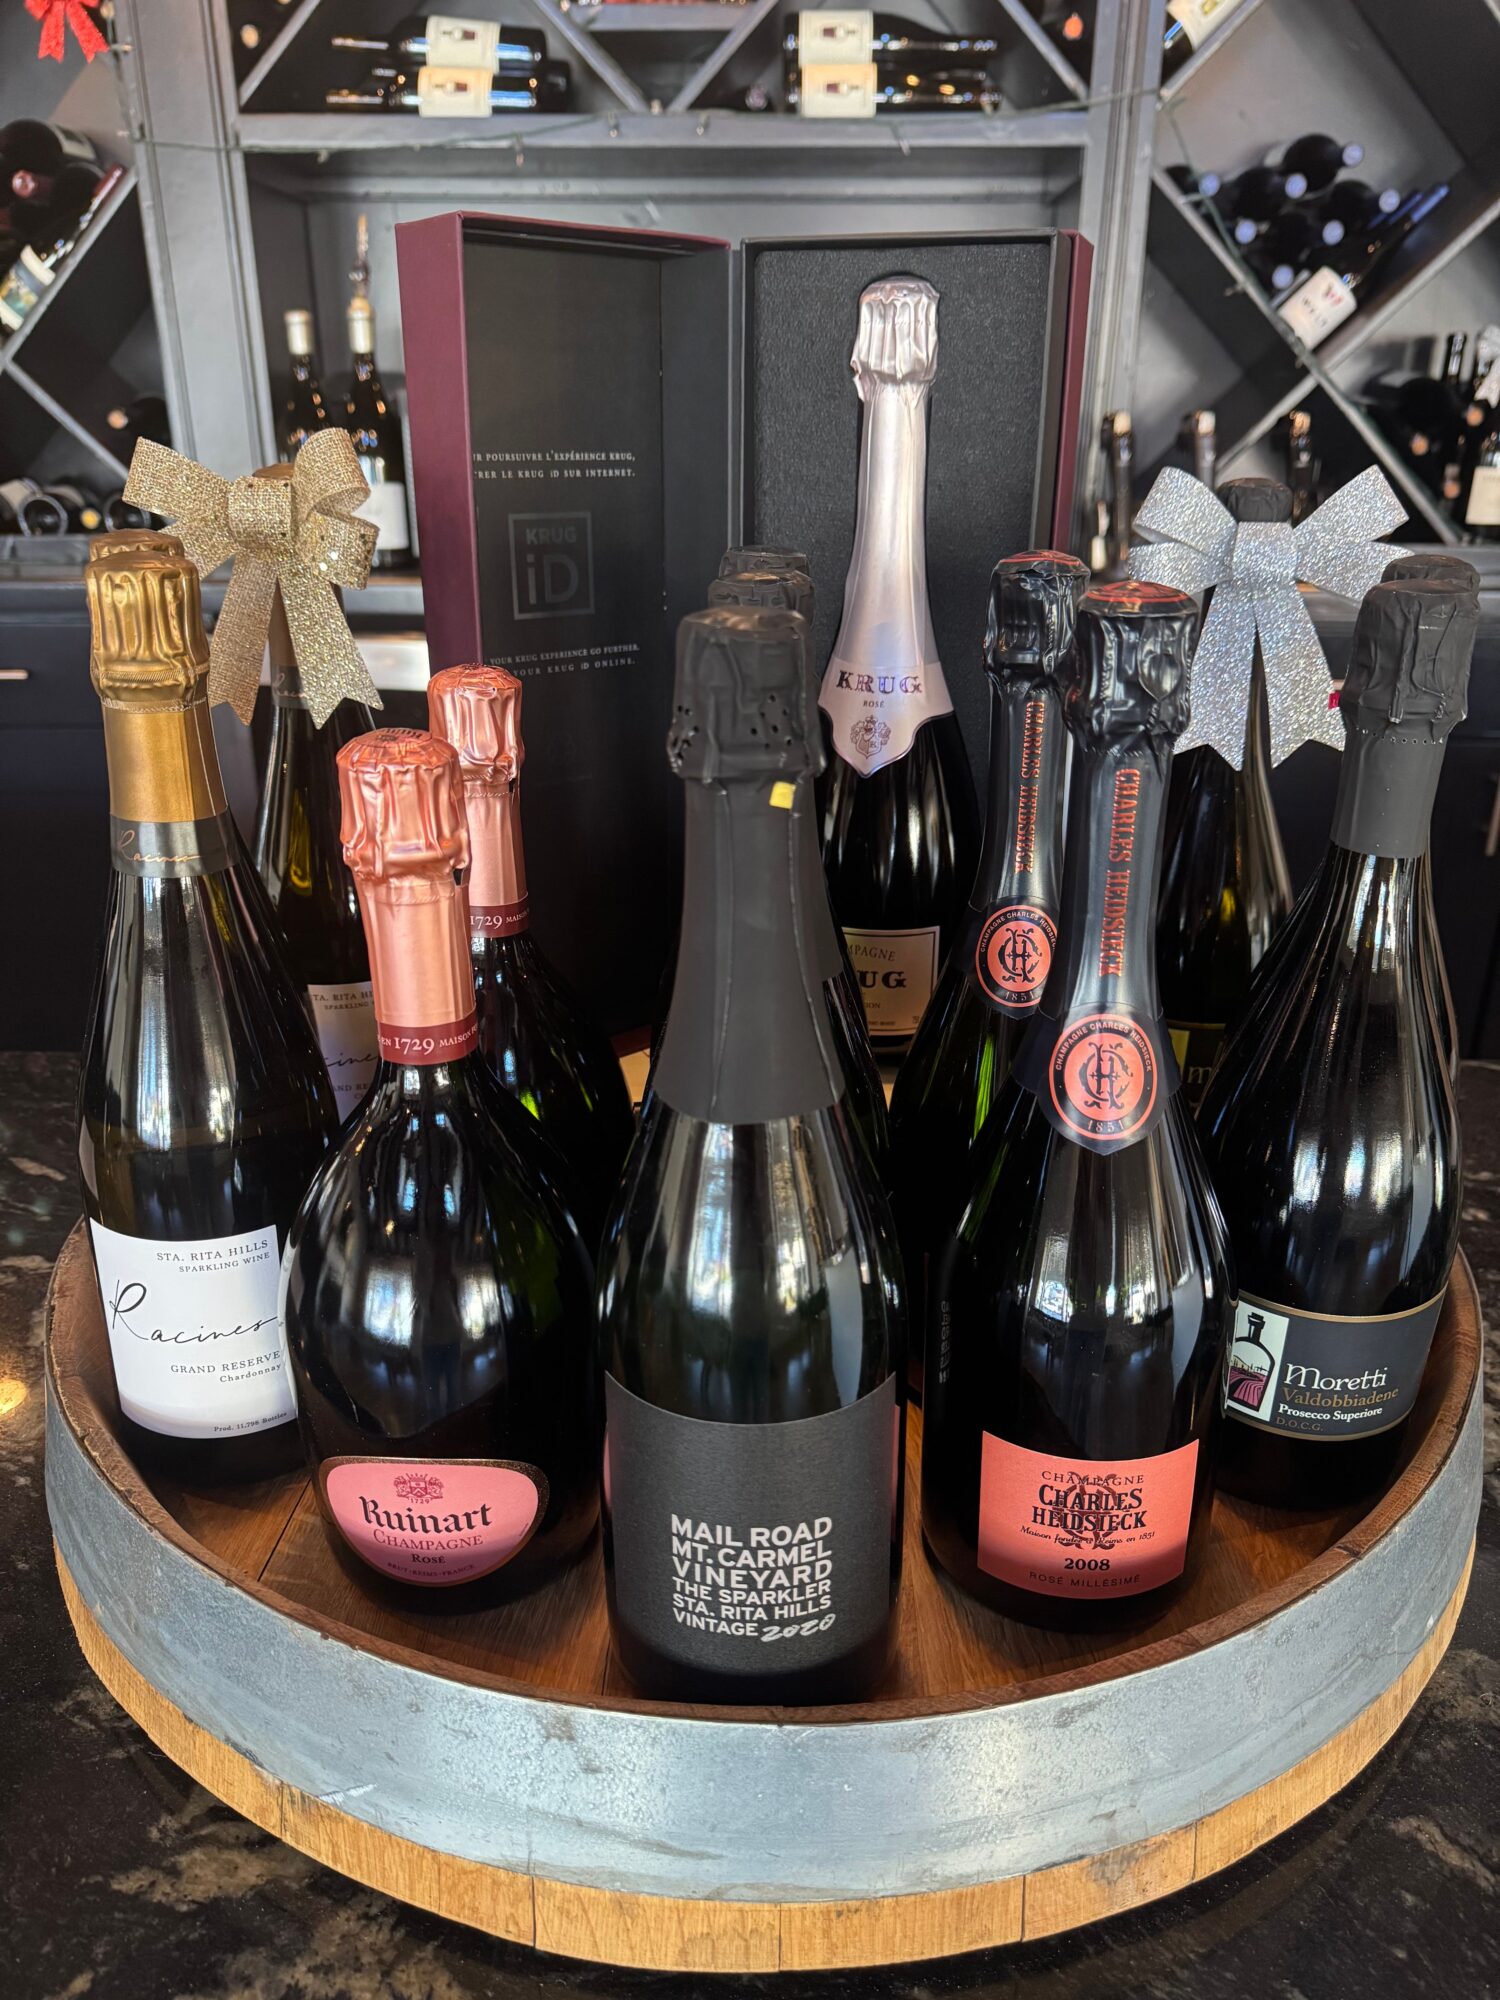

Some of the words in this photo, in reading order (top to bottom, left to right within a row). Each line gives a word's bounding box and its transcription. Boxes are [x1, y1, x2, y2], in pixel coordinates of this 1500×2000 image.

[486, 452, 543, 462] POURSUIVRE
[502, 470, 513, 478] LE
[518, 470, 544, 478] KRUG
[564, 469, 582, 478] SUR
[526, 527, 577, 545] KRUG
[526, 554, 580, 605] iD
[490, 656, 513, 666] YOUR
[515, 654, 538, 664] KRUG
[540, 650, 589, 662] EXPERIENCE
[590, 648, 602, 656] GO
[548, 663, 576, 674] KRUG
[836, 670, 923, 694] KRUG
[1020, 702, 1045, 779] CHARLES
[1108, 768, 1141, 863] CHARLES
[470, 915, 503, 930] 1729
[980, 916, 1006, 952] CHAMPAGNE
[1006, 911, 1039, 921] CHARLES
[1039, 918, 1056, 950] HEIDSIEC
[1099, 869, 1131, 977] HEIDSIECK
[856, 970, 907, 989] UG
[1005, 991, 1034, 1000] 1851
[393, 1037, 435, 1056] 1729
[438, 1032, 472, 1048] MAISON
[1055, 1026, 1088, 1071] CHAMPAGNE
[1090, 1021, 1130, 1034] CHARLES
[1130, 1030, 1152, 1072] HEIDSIECK
[1088, 1120, 1124, 1132] 1851
[156, 1252, 184, 1262] STA.
[190, 1250, 222, 1262] RITA
[228, 1239, 268, 1257] HILLS
[178, 1260, 240, 1273] SPARKLING
[243, 1251, 271, 1265] WINE
[109, 1279, 278, 1344] Racines
[170, 1364, 216, 1374] GRAND
[222, 1350, 282, 1372] RESERVE
[220, 1363, 282, 1383] Chardonnay
[1284, 1363, 1389, 1391] Moretti
[1282, 1386, 1398, 1408] Valdobbiadene
[1276, 1416, 1324, 1432] D.O.C.G.
[1278, 1402, 1331, 1420] Prosecco
[1332, 1406, 1382, 1422] Superiore
[1042, 1470, 1145, 1486] CHAMPAGNE
[1038, 1484, 1142, 1511] CHARLES
[358, 1496, 492, 1534] Ruinart
[1032, 1505, 1148, 1532] HEIDSIECK
[373, 1528, 484, 1551] CHAMPAGNE
[672, 1514, 743, 1547] MAIL
[750, 1516, 832, 1548] ROAD
[1020, 1525, 1052, 1540] Maison
[672, 1535, 714, 1564] MT.
[718, 1540, 832, 1568] CARMEL
[672, 1556, 832, 1590] VINEYARD
[1064, 1558, 1110, 1571] 2008
[672, 1576, 712, 1600] THE
[718, 1579, 832, 1604] SPARKLER
[672, 1593, 716, 1617] STA.
[720, 1604, 768, 1620] RITA
[774, 1595, 832, 1619] HILLS
[672, 1607, 759, 1636] VINTAGE
[760, 1613, 836, 1642] 2020
